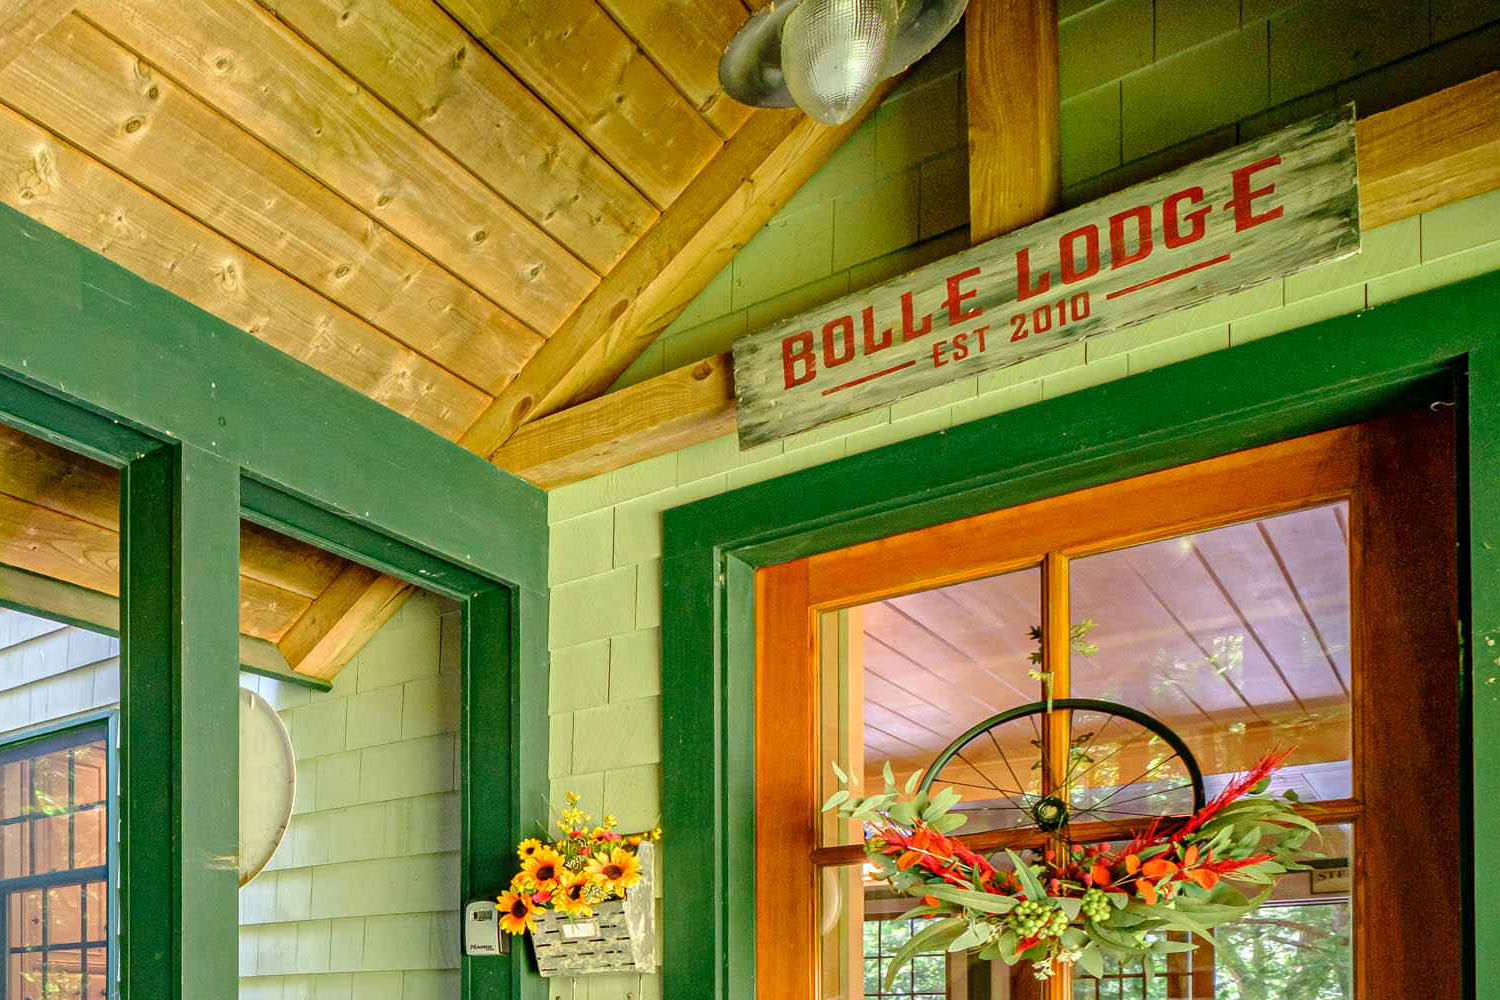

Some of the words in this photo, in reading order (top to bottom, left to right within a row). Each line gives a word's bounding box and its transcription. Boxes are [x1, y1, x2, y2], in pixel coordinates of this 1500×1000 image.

[781, 266, 984, 391] BOLLE
[1016, 153, 1286, 303] LODGE
[928, 324, 991, 369] EST
[1009, 291, 1092, 344] 2010
